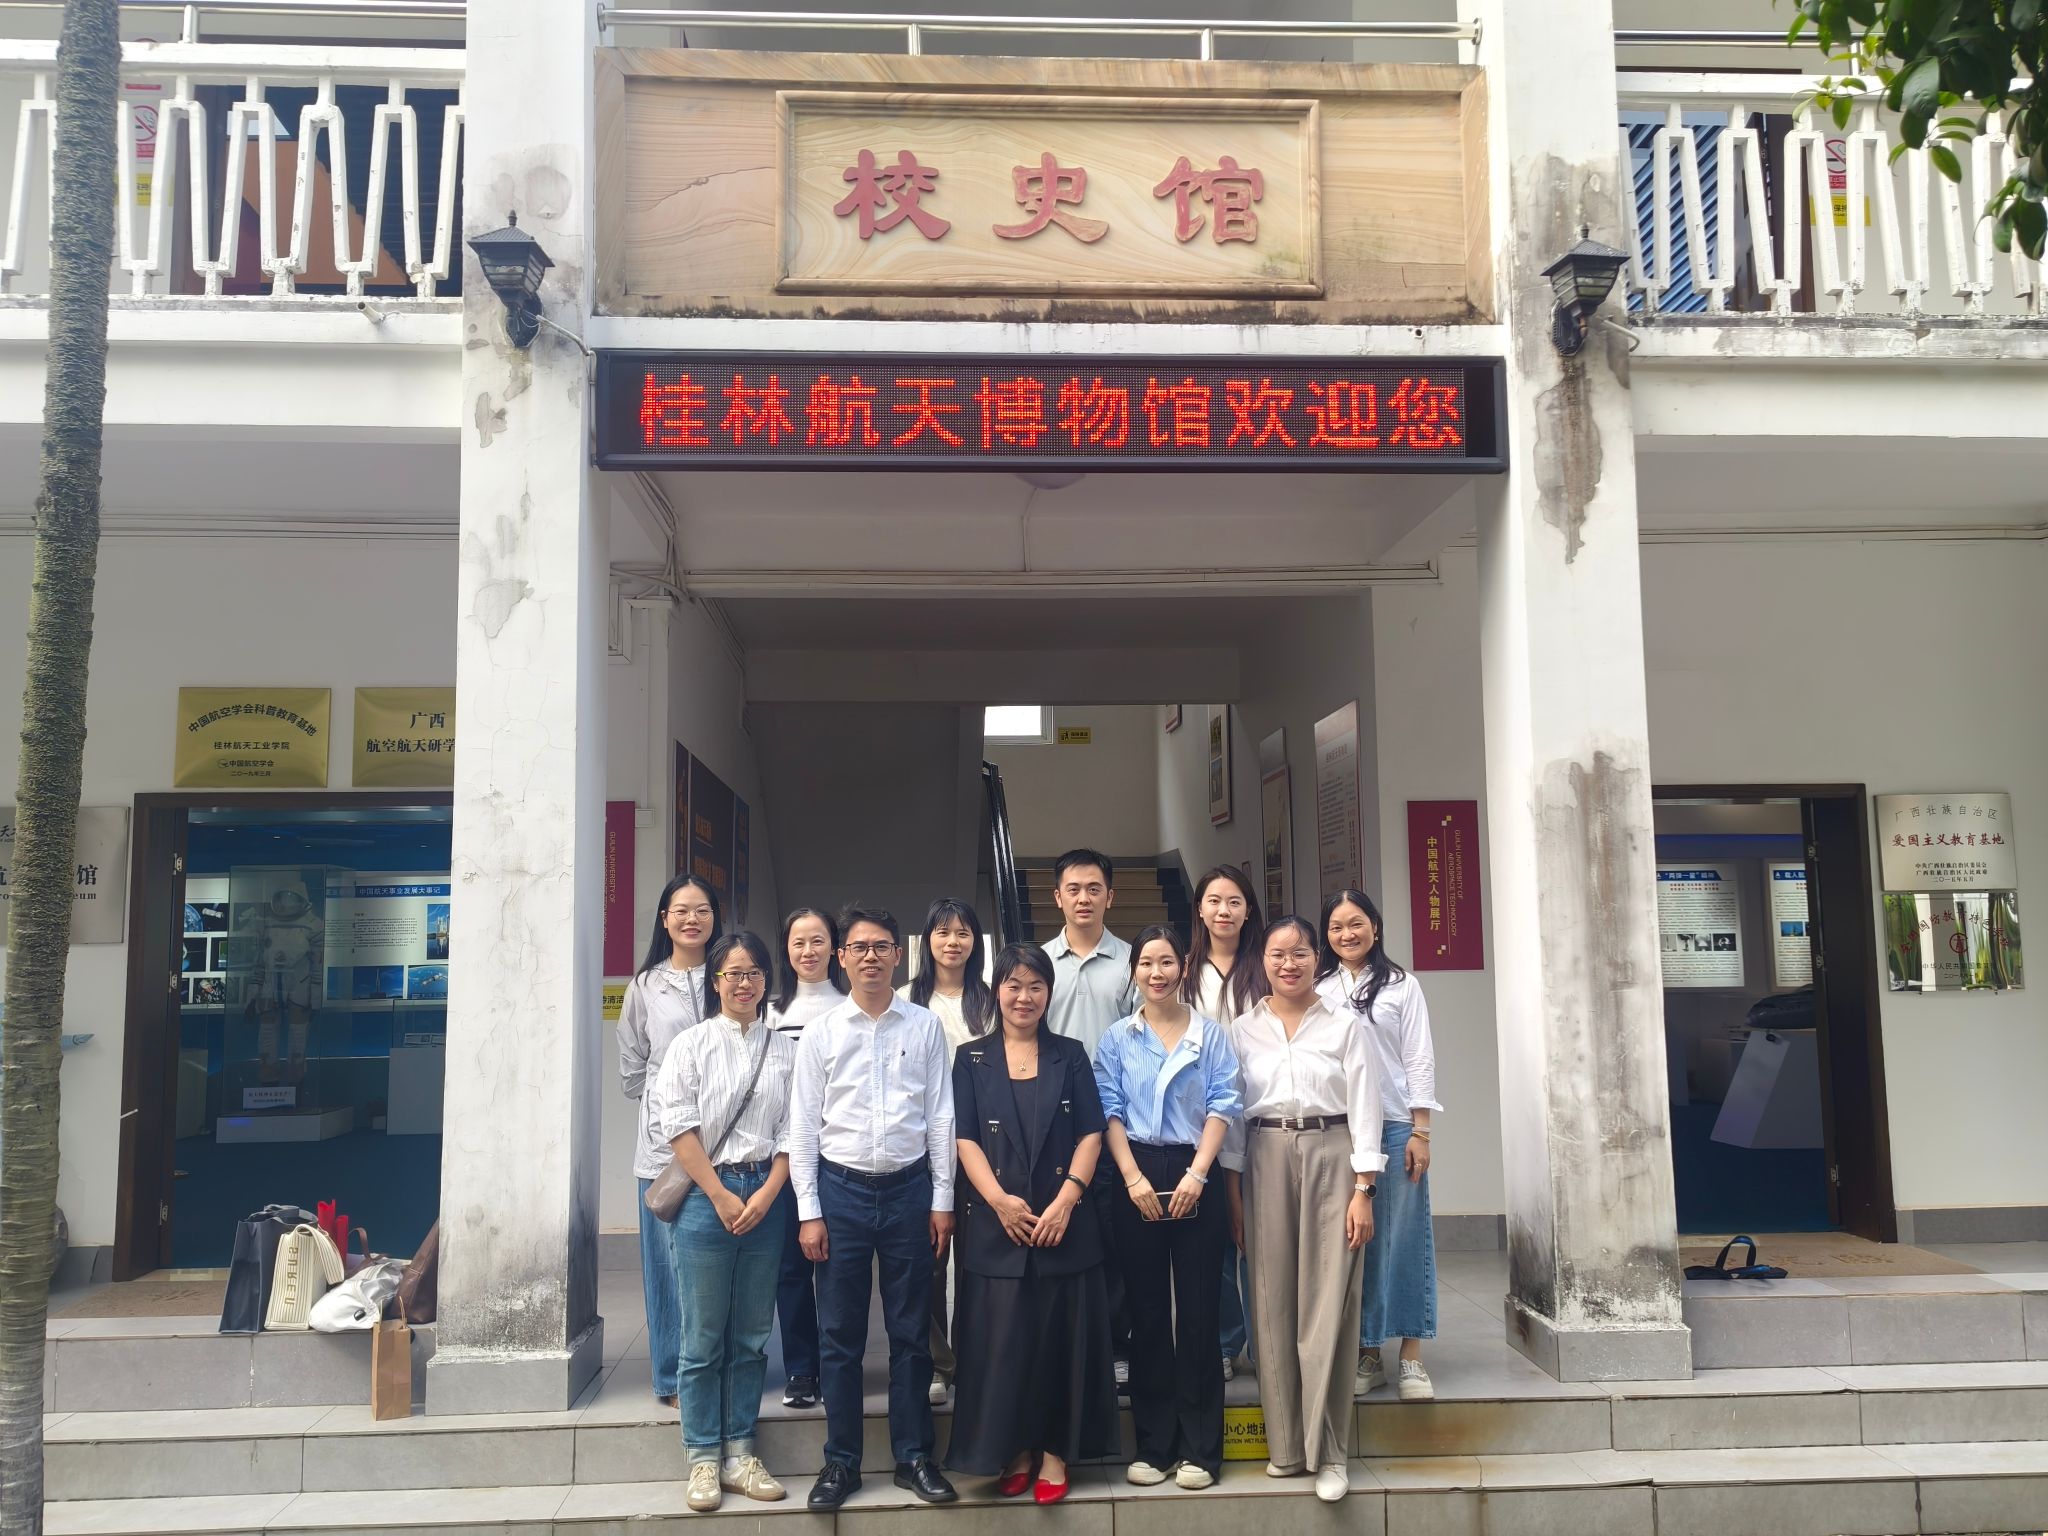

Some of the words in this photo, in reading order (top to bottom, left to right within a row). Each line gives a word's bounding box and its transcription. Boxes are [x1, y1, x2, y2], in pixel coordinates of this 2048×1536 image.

[834, 149, 1265, 243] 校史馆
[640, 373, 1462, 449] 桂林航天博物馆欢迎您
[188, 704, 317, 736] 中国航空学会科普教育基地
[410, 712, 446, 729] 广西
[214, 742, 290, 750] 桂林航天工业学院
[229, 760, 274, 768] 中国航空学会
[1895, 804, 1998, 822] 广西壮族自治区
[1892, 833, 2005, 848] 爱国主义教育基地
[1448, 852, 1457, 892] AEROSPACE
[1456, 852, 1464, 888] UNIVERSITY
[360, 886, 441, 895] 中国航天事业发展大事记
[1427, 836, 1441, 931] 中国航天人物展厅
[609, 893, 616, 903] OF
[1457, 890, 1464, 900] OF
